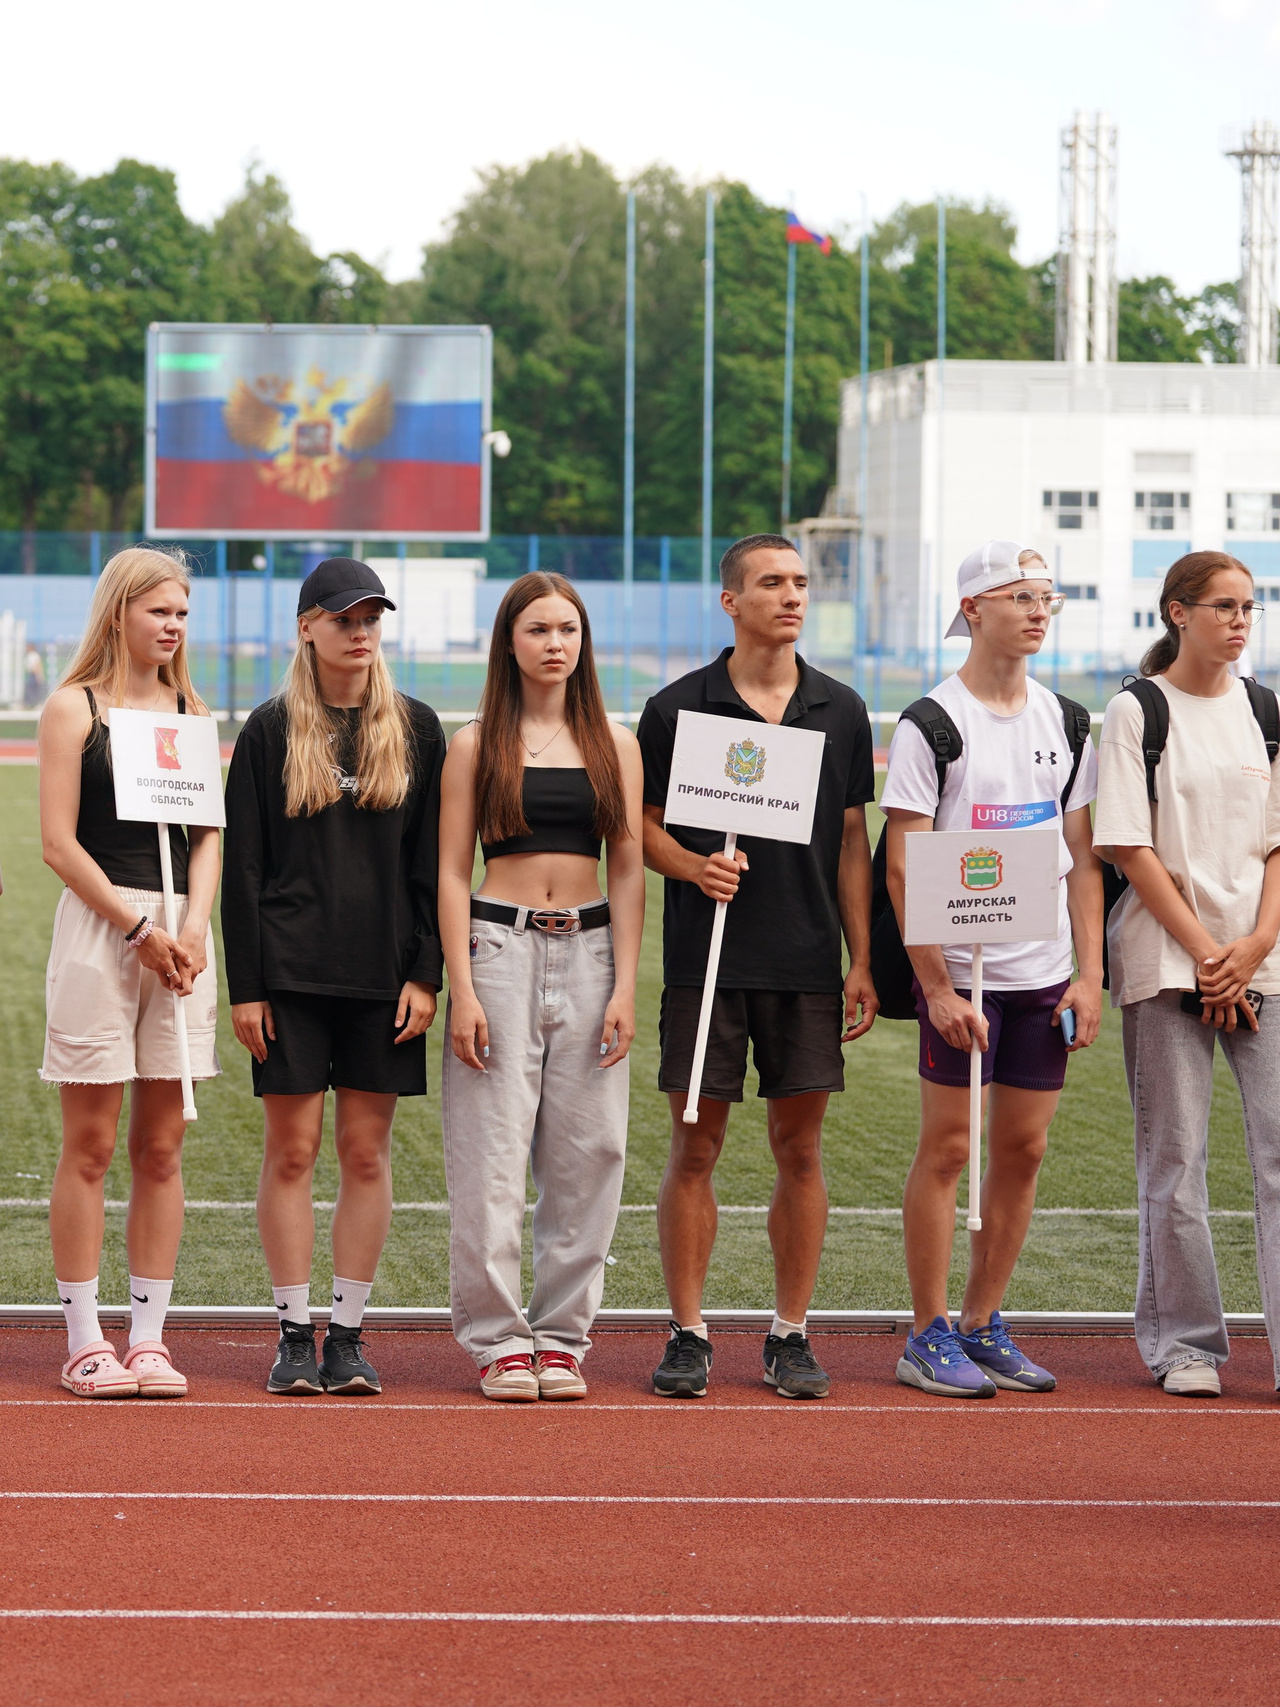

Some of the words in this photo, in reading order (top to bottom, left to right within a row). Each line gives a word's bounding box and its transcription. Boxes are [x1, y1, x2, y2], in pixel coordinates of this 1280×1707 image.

[136, 777, 205, 792] ВОЛОГОДСКАЯ
[151, 794, 194, 806] ОБЛАСТЬ
[677, 784, 764, 806] ПРИМОРСКИЙ
[767, 798, 800, 812] КРАЙ
[977, 808, 1008, 822] U18
[947, 896, 1016, 909] АМУРСКАЯ
[951, 913, 1013, 925] ОБЛАСТЬ
